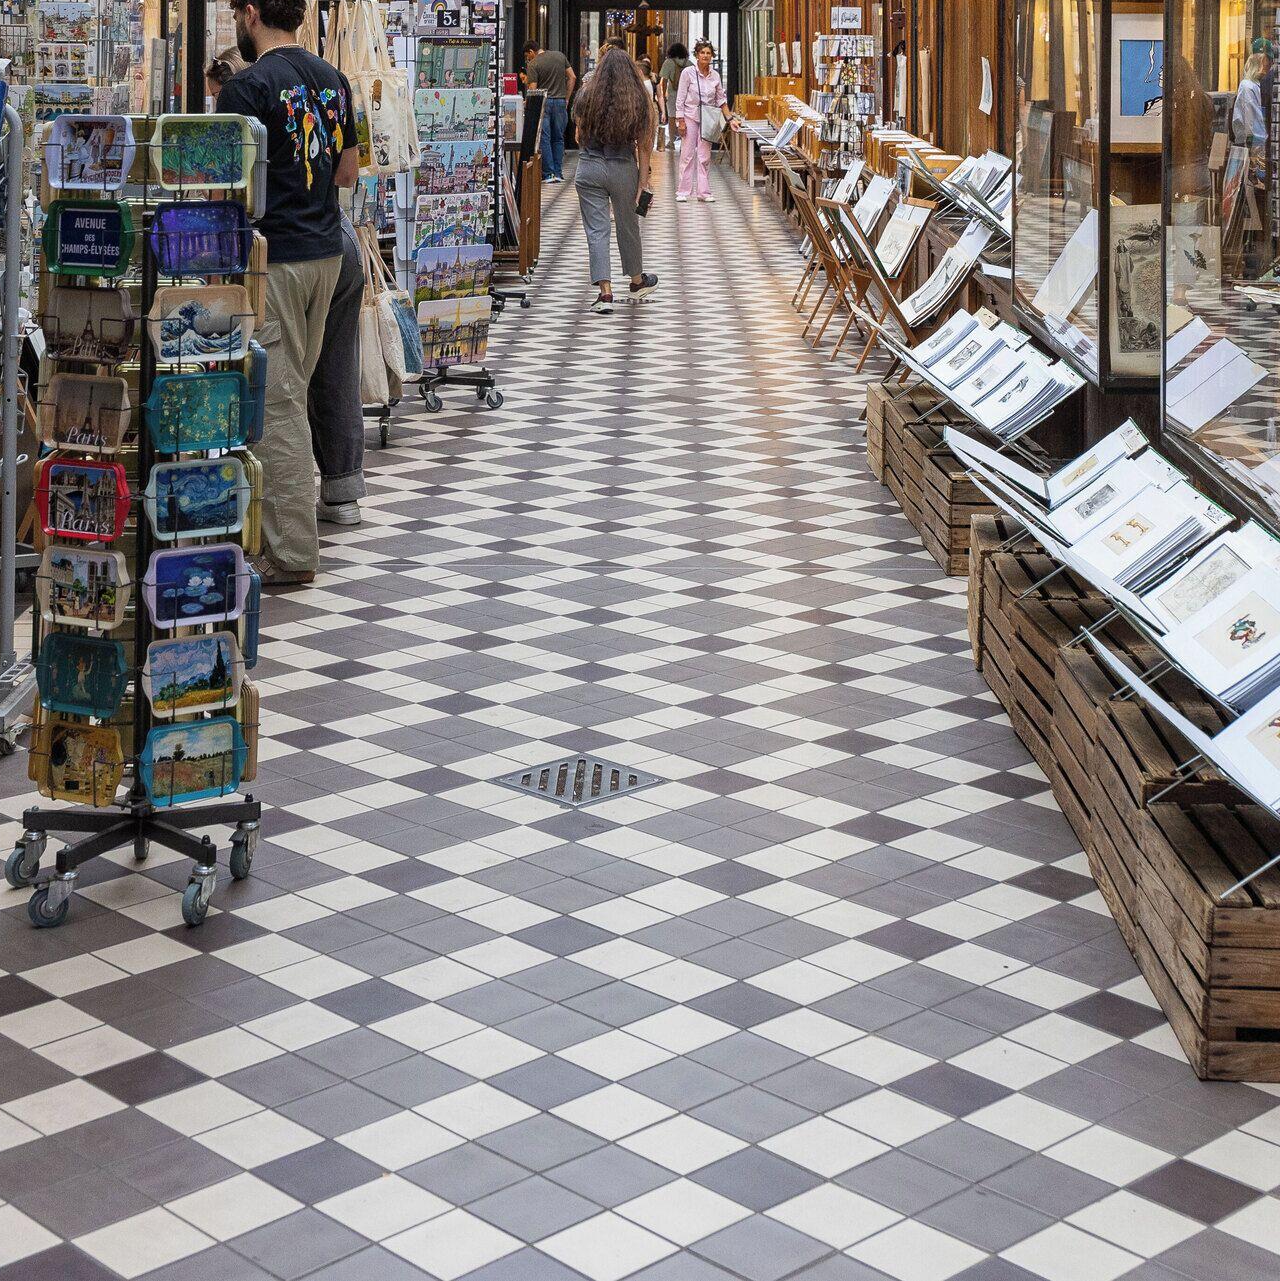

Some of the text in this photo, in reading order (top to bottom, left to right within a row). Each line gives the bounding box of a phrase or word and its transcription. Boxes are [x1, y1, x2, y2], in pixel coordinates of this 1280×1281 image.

[74, 217, 107, 230] AVENUE
[84, 233, 96, 242] DES
[66, 426, 108, 448] Paris
[61, 510, 111, 534] Paris
